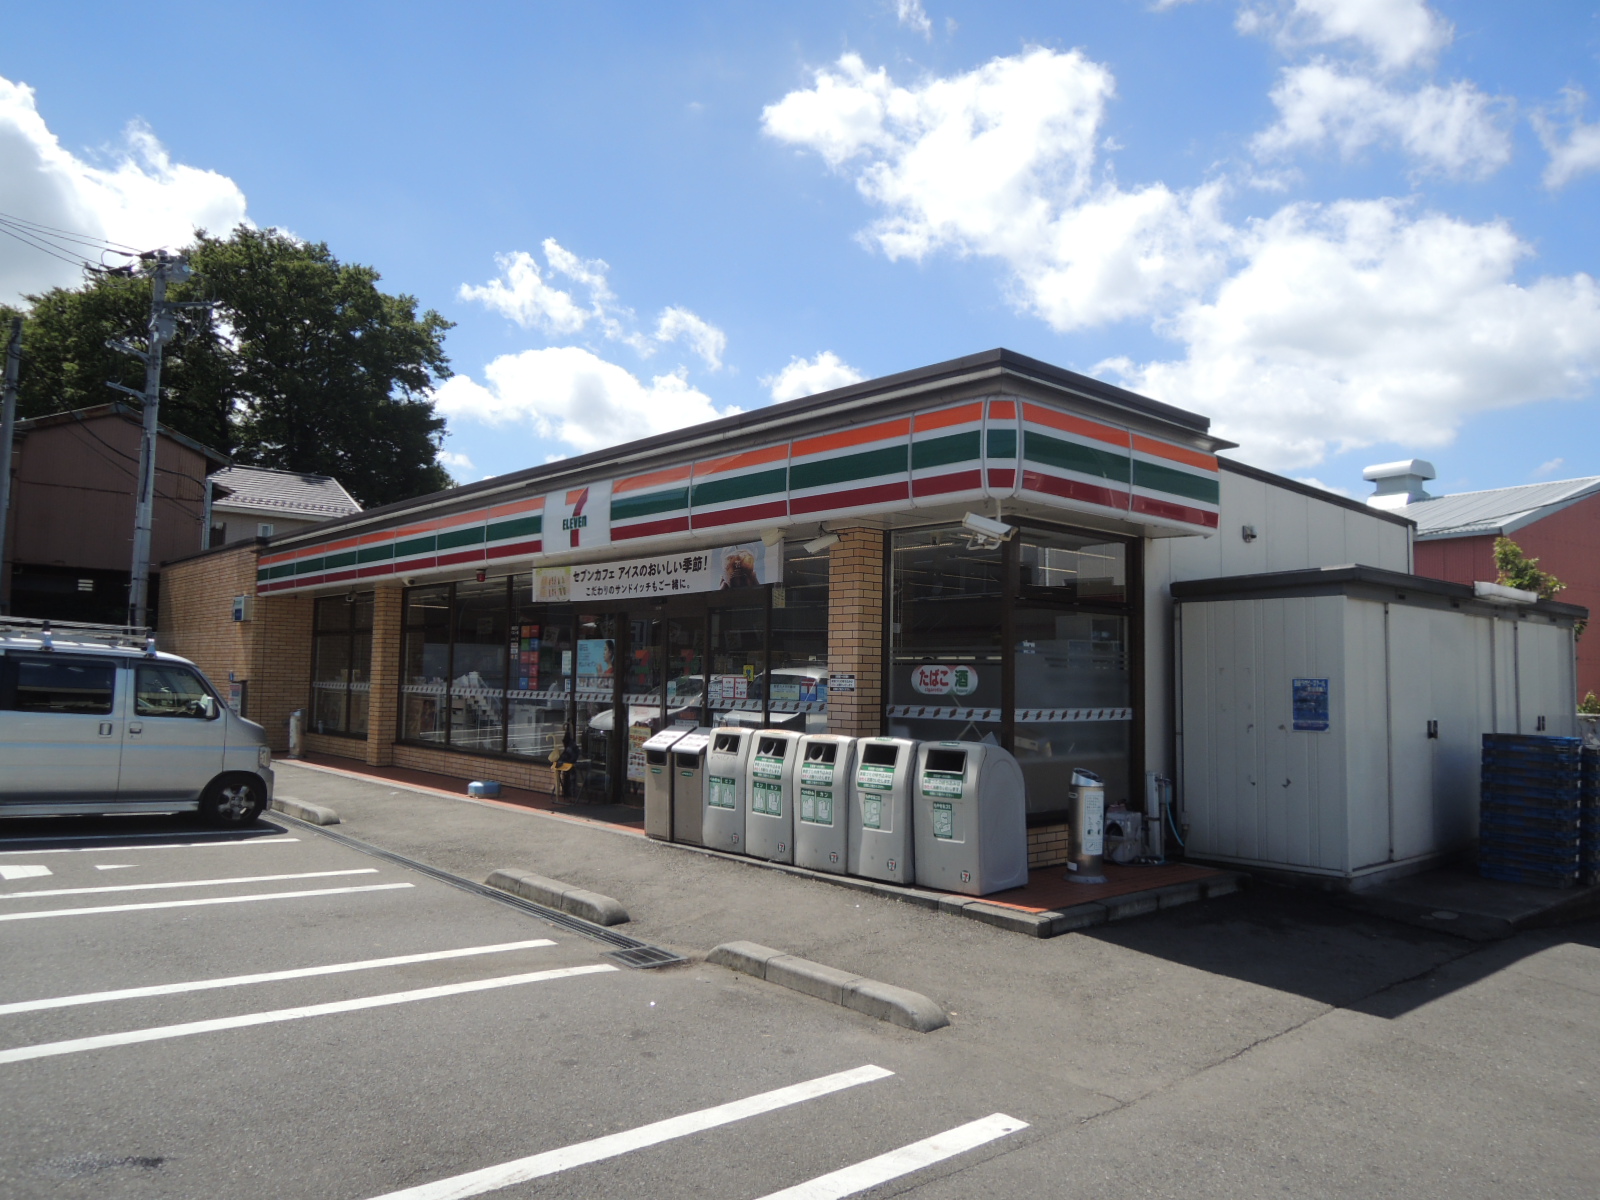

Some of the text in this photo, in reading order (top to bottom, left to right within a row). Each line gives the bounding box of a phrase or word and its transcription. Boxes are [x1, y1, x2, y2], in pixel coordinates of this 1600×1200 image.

[572, 568, 616, 583] セブンカフェ
[585, 578, 691, 597] こだわりのサンドイッチもご一緒に。
[918, 668, 949, 687] たばこ
[954, 669, 969, 688] 酒
